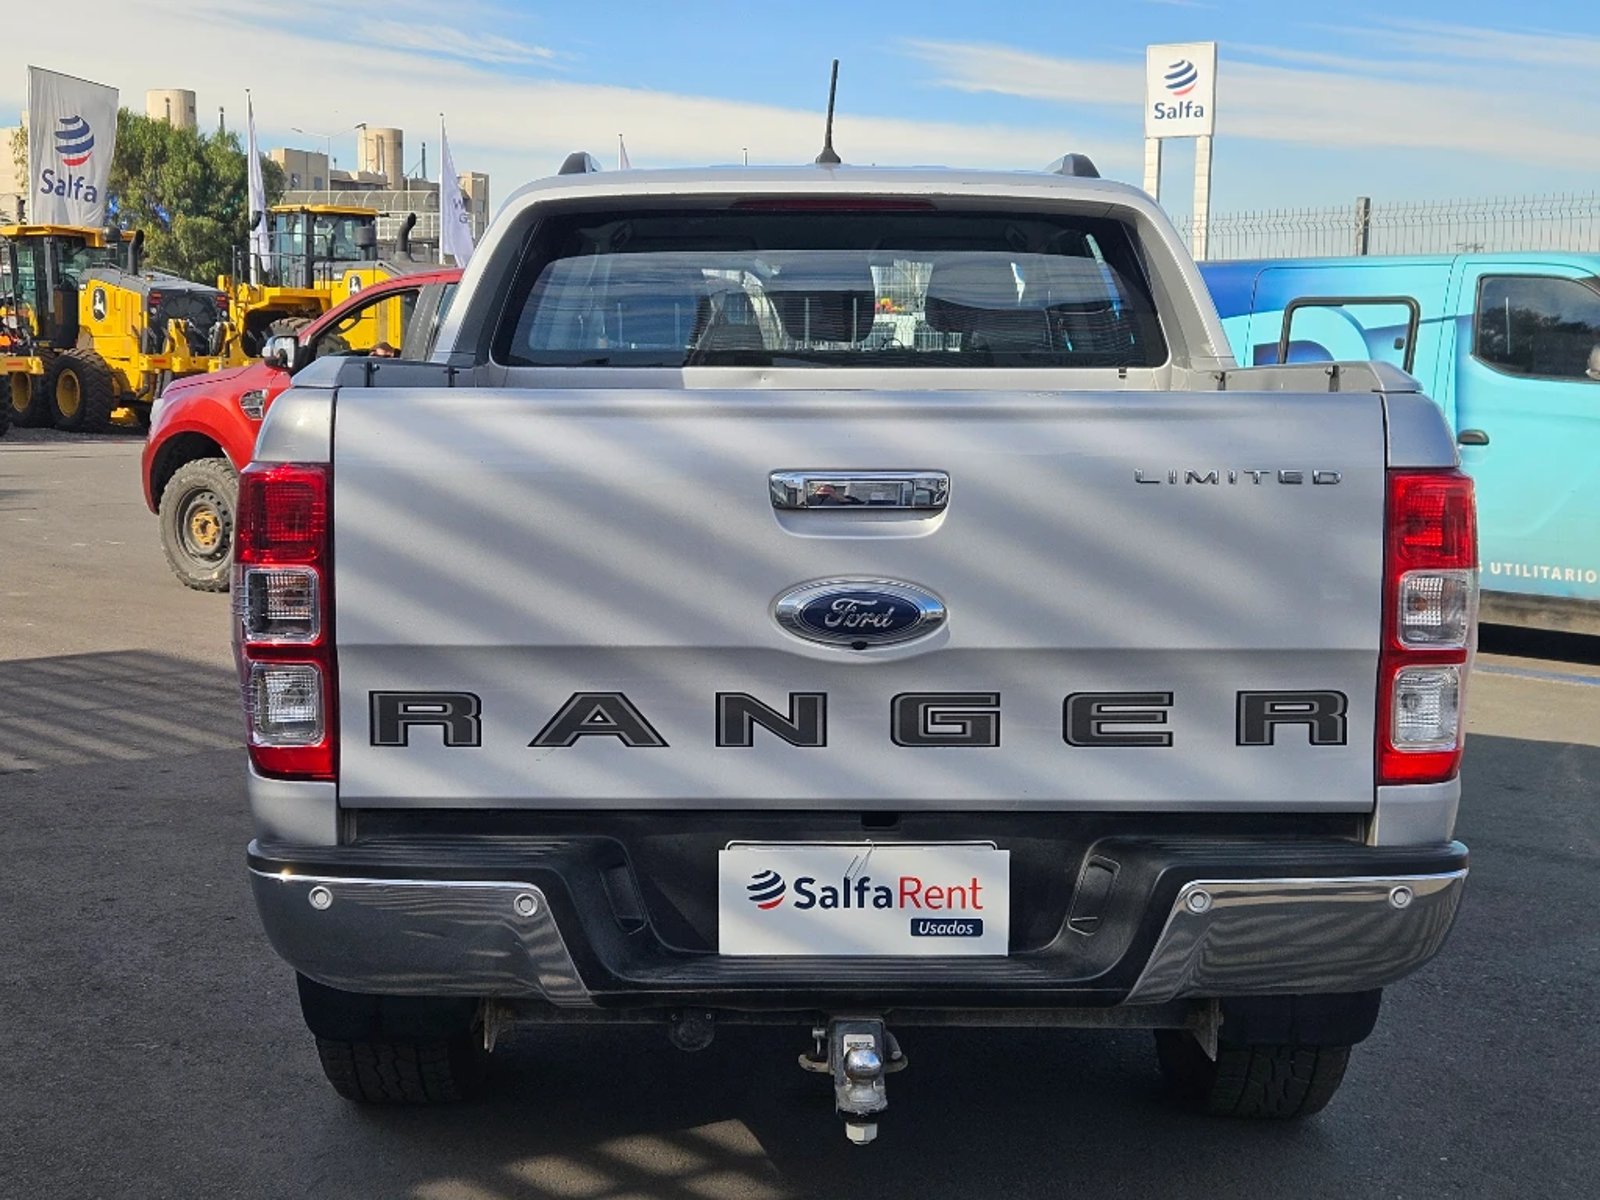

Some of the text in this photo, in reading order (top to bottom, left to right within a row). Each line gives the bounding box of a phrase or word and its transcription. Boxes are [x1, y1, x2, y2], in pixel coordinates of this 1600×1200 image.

[1154, 100, 1204, 120] Salfa
[40, 168, 98, 204] Salfa
[1134, 468, 1343, 485] LIMITED
[1490, 561, 1598, 584] UTILITARIO
[824, 597, 895, 628] Ford
[369, 690, 1349, 748] RANGER
[793, 876, 983, 910] SalfaRent
[918, 920, 974, 935] Usados
